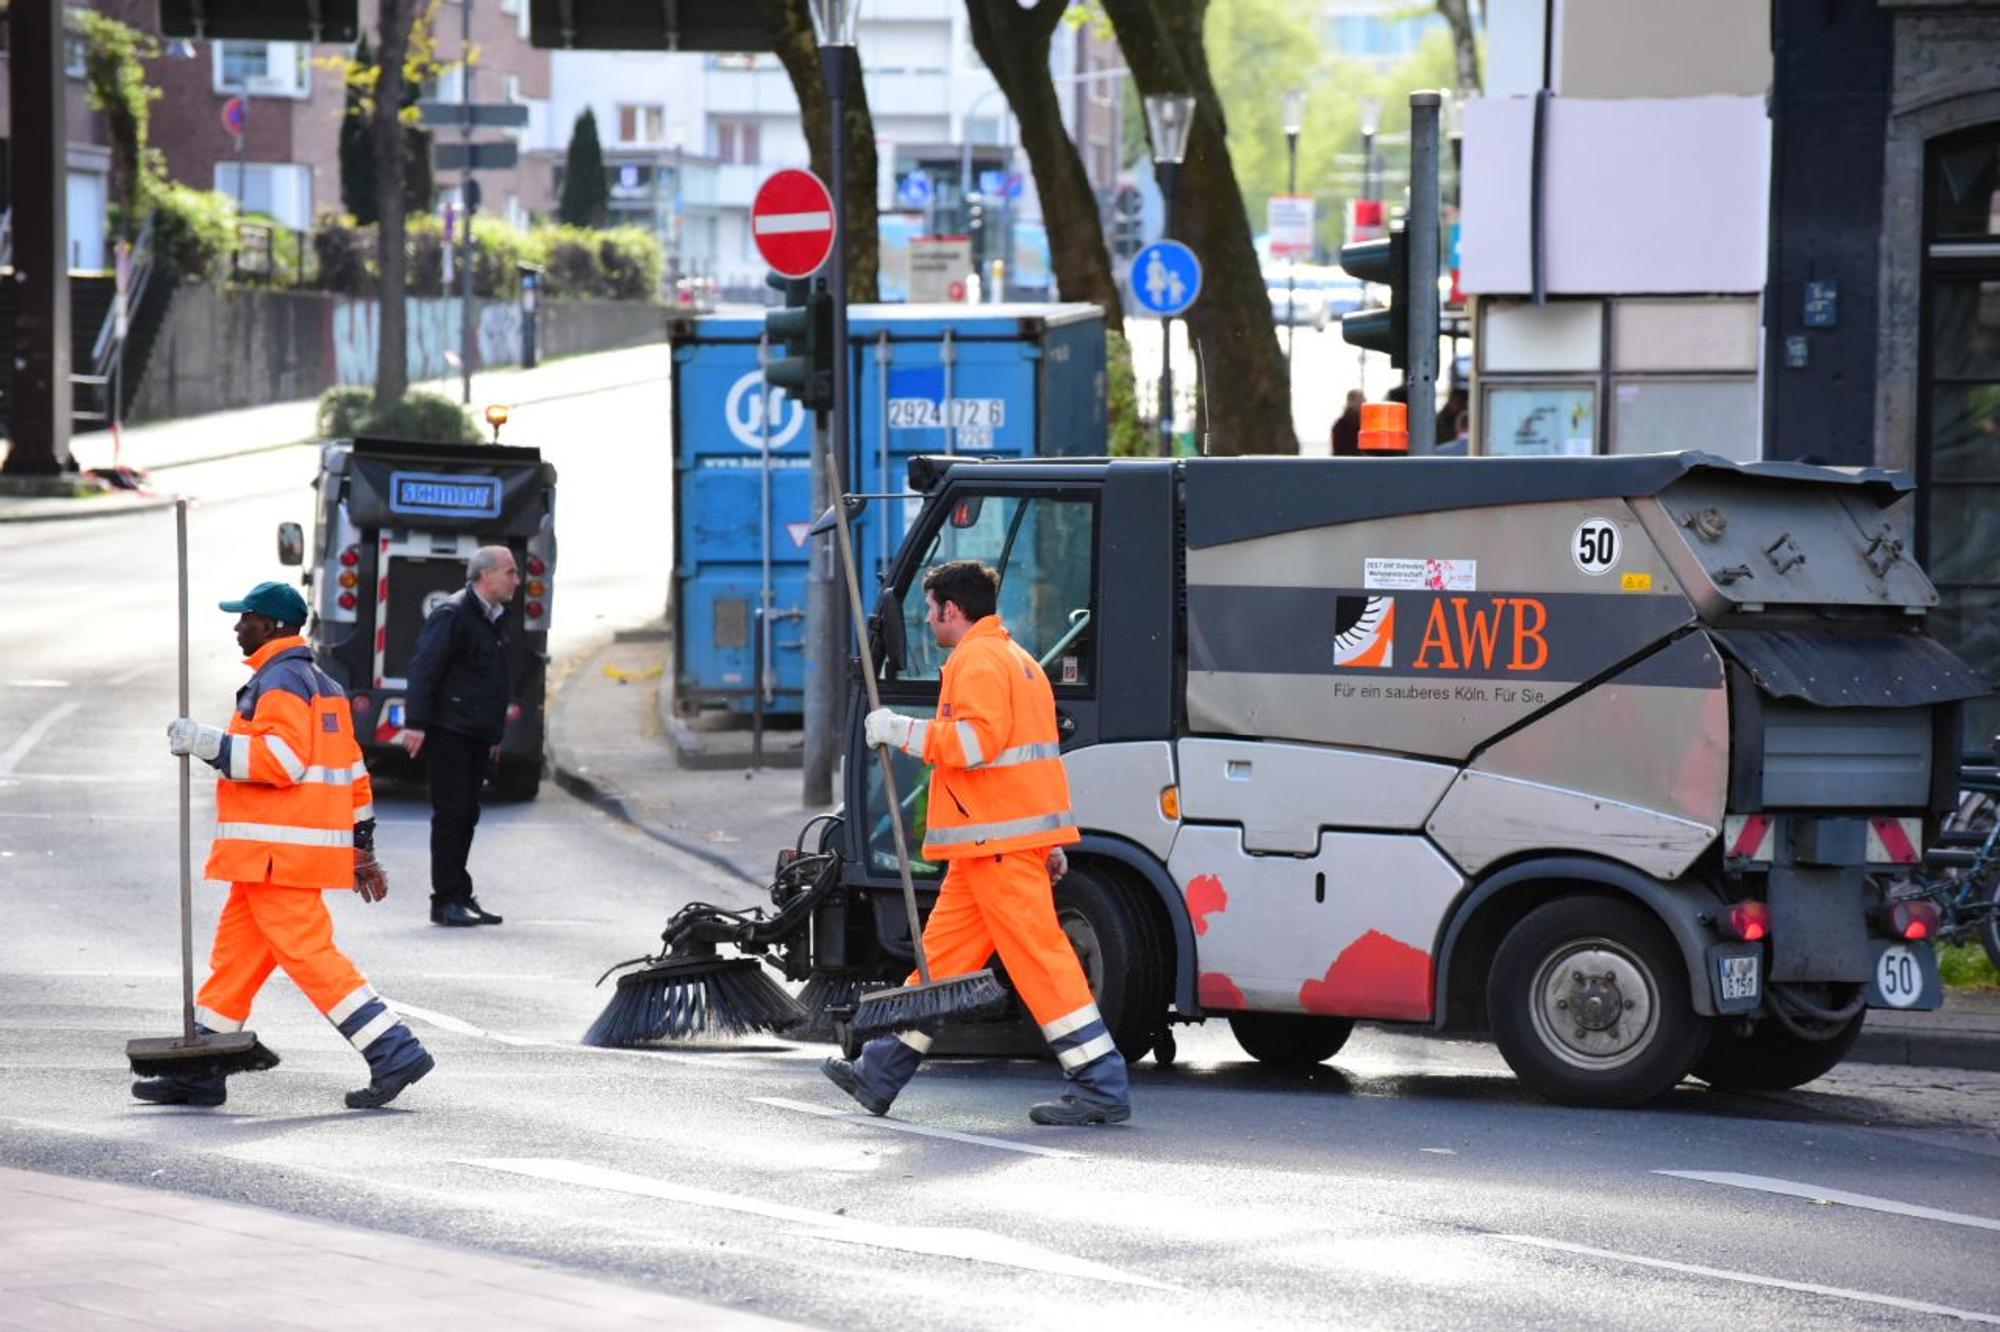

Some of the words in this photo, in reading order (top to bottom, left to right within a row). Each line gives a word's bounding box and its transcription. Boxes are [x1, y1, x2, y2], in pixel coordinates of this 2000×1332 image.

[1579, 527, 1614, 565] 50
[1412, 597, 1549, 670] AWB
[1333, 683, 1355, 697] Für
[1361, 684, 1381, 698] ein
[1385, 684, 1450, 700] sauberes
[1455, 686, 1488, 701] Köln.
[1495, 687, 1516, 702] Für
[1521, 688, 1546, 703] Sie.
[1885, 955, 1914, 995] 50
